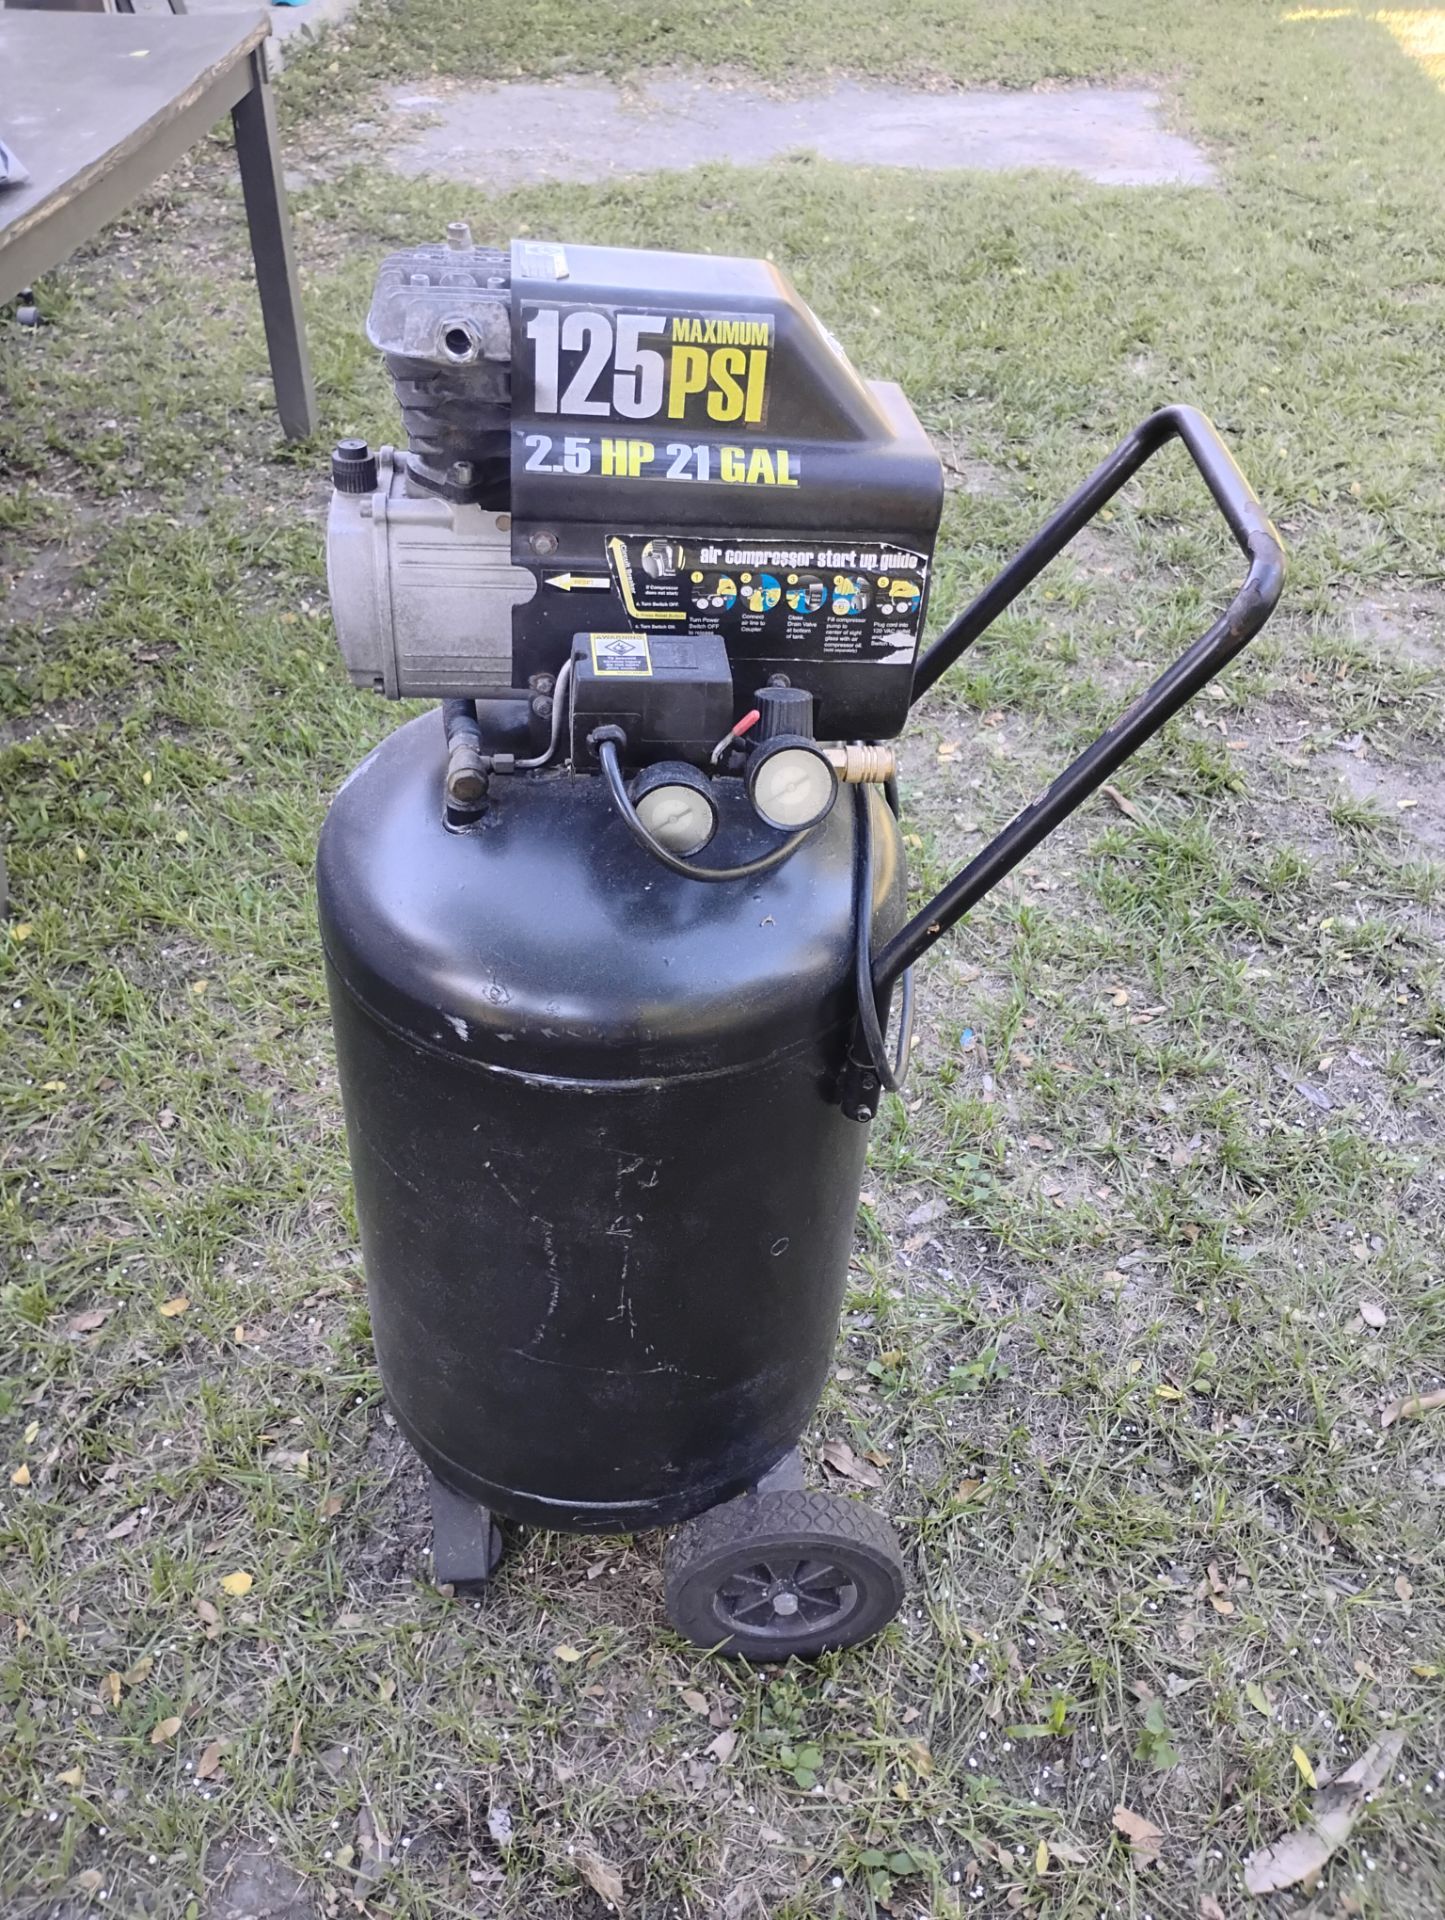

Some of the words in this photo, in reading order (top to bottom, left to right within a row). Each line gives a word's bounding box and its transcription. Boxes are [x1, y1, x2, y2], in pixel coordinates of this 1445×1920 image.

[672, 318, 769, 346] MAXIMUM
[527, 309, 667, 419] 125
[668, 345, 768, 423] PSI
[525, 435, 591, 474] 2.5
[601, 439, 655, 477] HP
[666, 444, 710, 481] 21
[720, 447, 798, 485] GAL
[700, 546, 722, 564] air
[725, 550, 815, 568] compressor
[817, 550, 857, 568] start
[860, 554, 879, 571] up
[880, 552, 918, 571] guide
